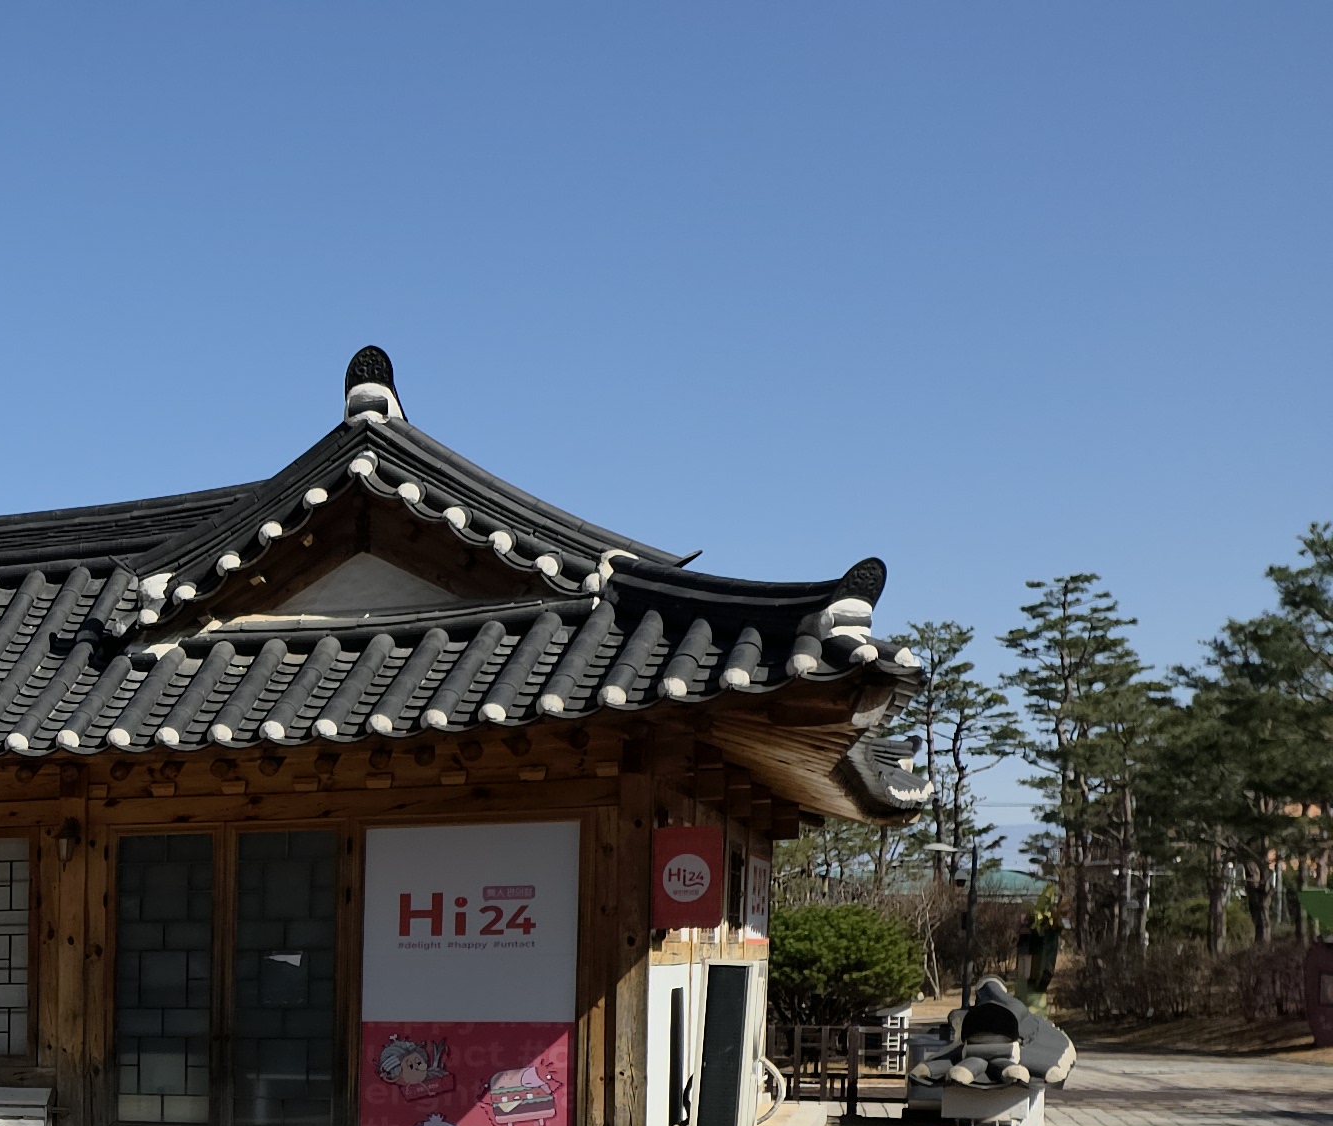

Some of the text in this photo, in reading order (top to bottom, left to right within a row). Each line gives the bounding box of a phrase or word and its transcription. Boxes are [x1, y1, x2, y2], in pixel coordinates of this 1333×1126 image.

[398, 940, 535, 950] #delight #happy #untact
